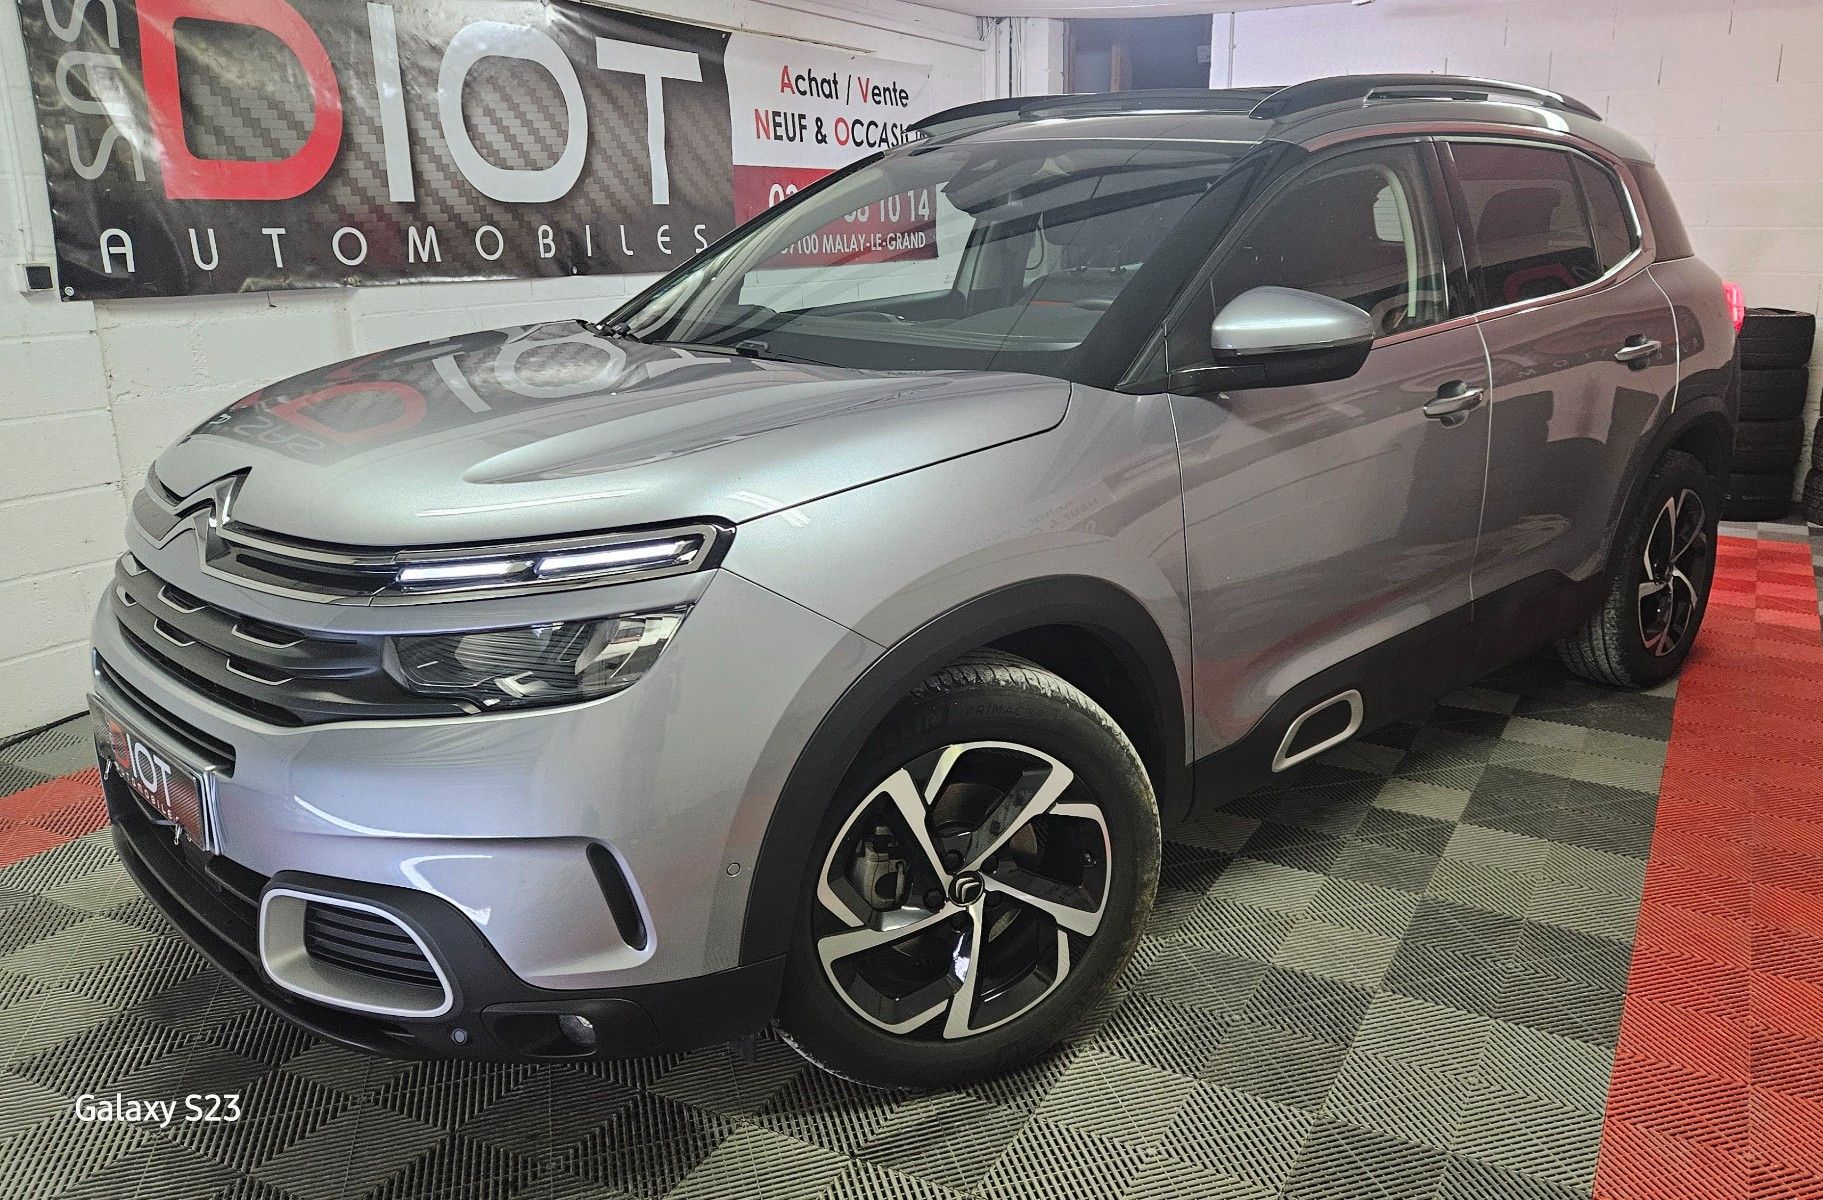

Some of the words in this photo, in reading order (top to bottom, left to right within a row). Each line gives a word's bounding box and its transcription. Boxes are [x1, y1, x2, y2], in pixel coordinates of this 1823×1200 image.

[138, 0, 703, 205] DIOT
[780, 65, 840, 100] Achat
[857, 77, 909, 108] Vente
[754, 109, 808, 142] NEUF
[815, 117, 828, 145] &
[908, 189, 930, 222] 14
[100, 223, 709, 275] AUTOMOBILES
[822, 231, 926, 254] MALAY-LE-GRAND
[109, 719, 172, 808] DIOT
